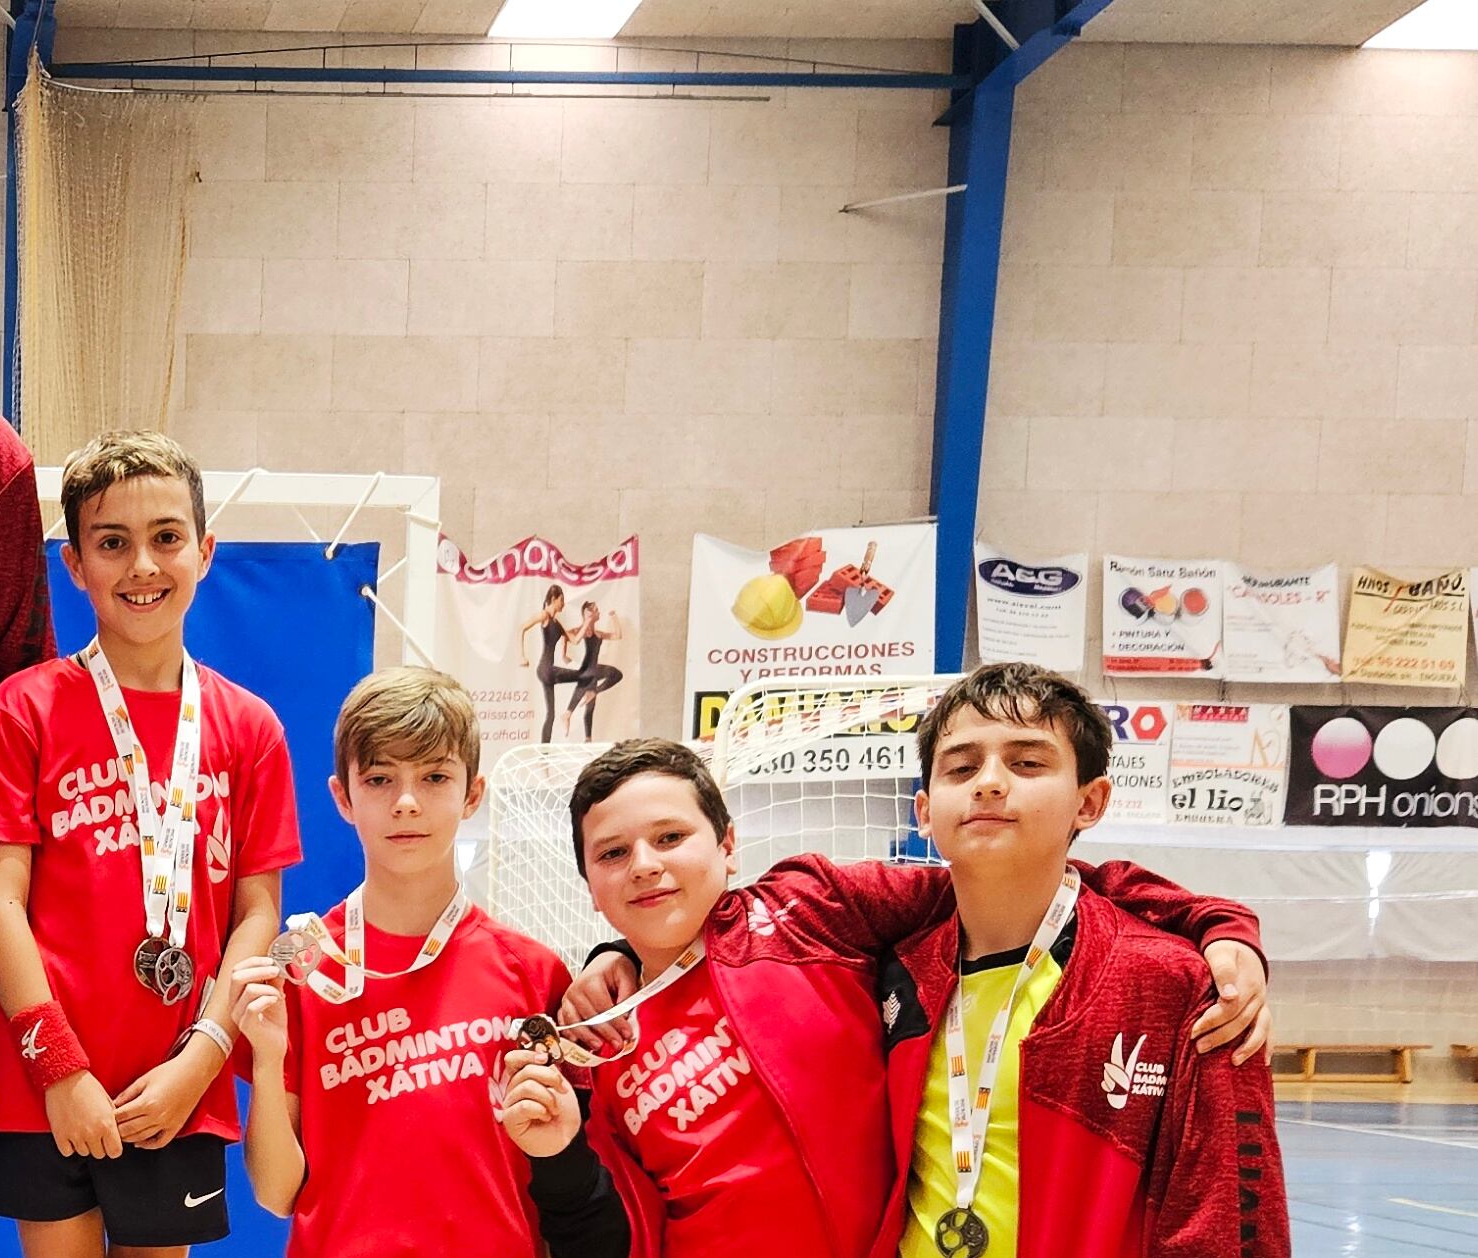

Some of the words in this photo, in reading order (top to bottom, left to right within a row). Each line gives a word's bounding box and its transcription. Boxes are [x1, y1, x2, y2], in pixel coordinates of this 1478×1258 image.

[1119, 630, 1162, 639] PINTURA
[708, 641, 916, 665] CONSTRUCCIONES
[740, 668, 754, 684] Y
[803, 748, 849, 773] 350
[859, 746, 905, 771] 461
[1171, 788, 1197, 810] el
[1312, 783, 1386, 816] RPH
[325, 1007, 411, 1054] CLUB
[616, 1028, 689, 1098] CLUB
[1135, 1062, 1164, 1074] CLUB
